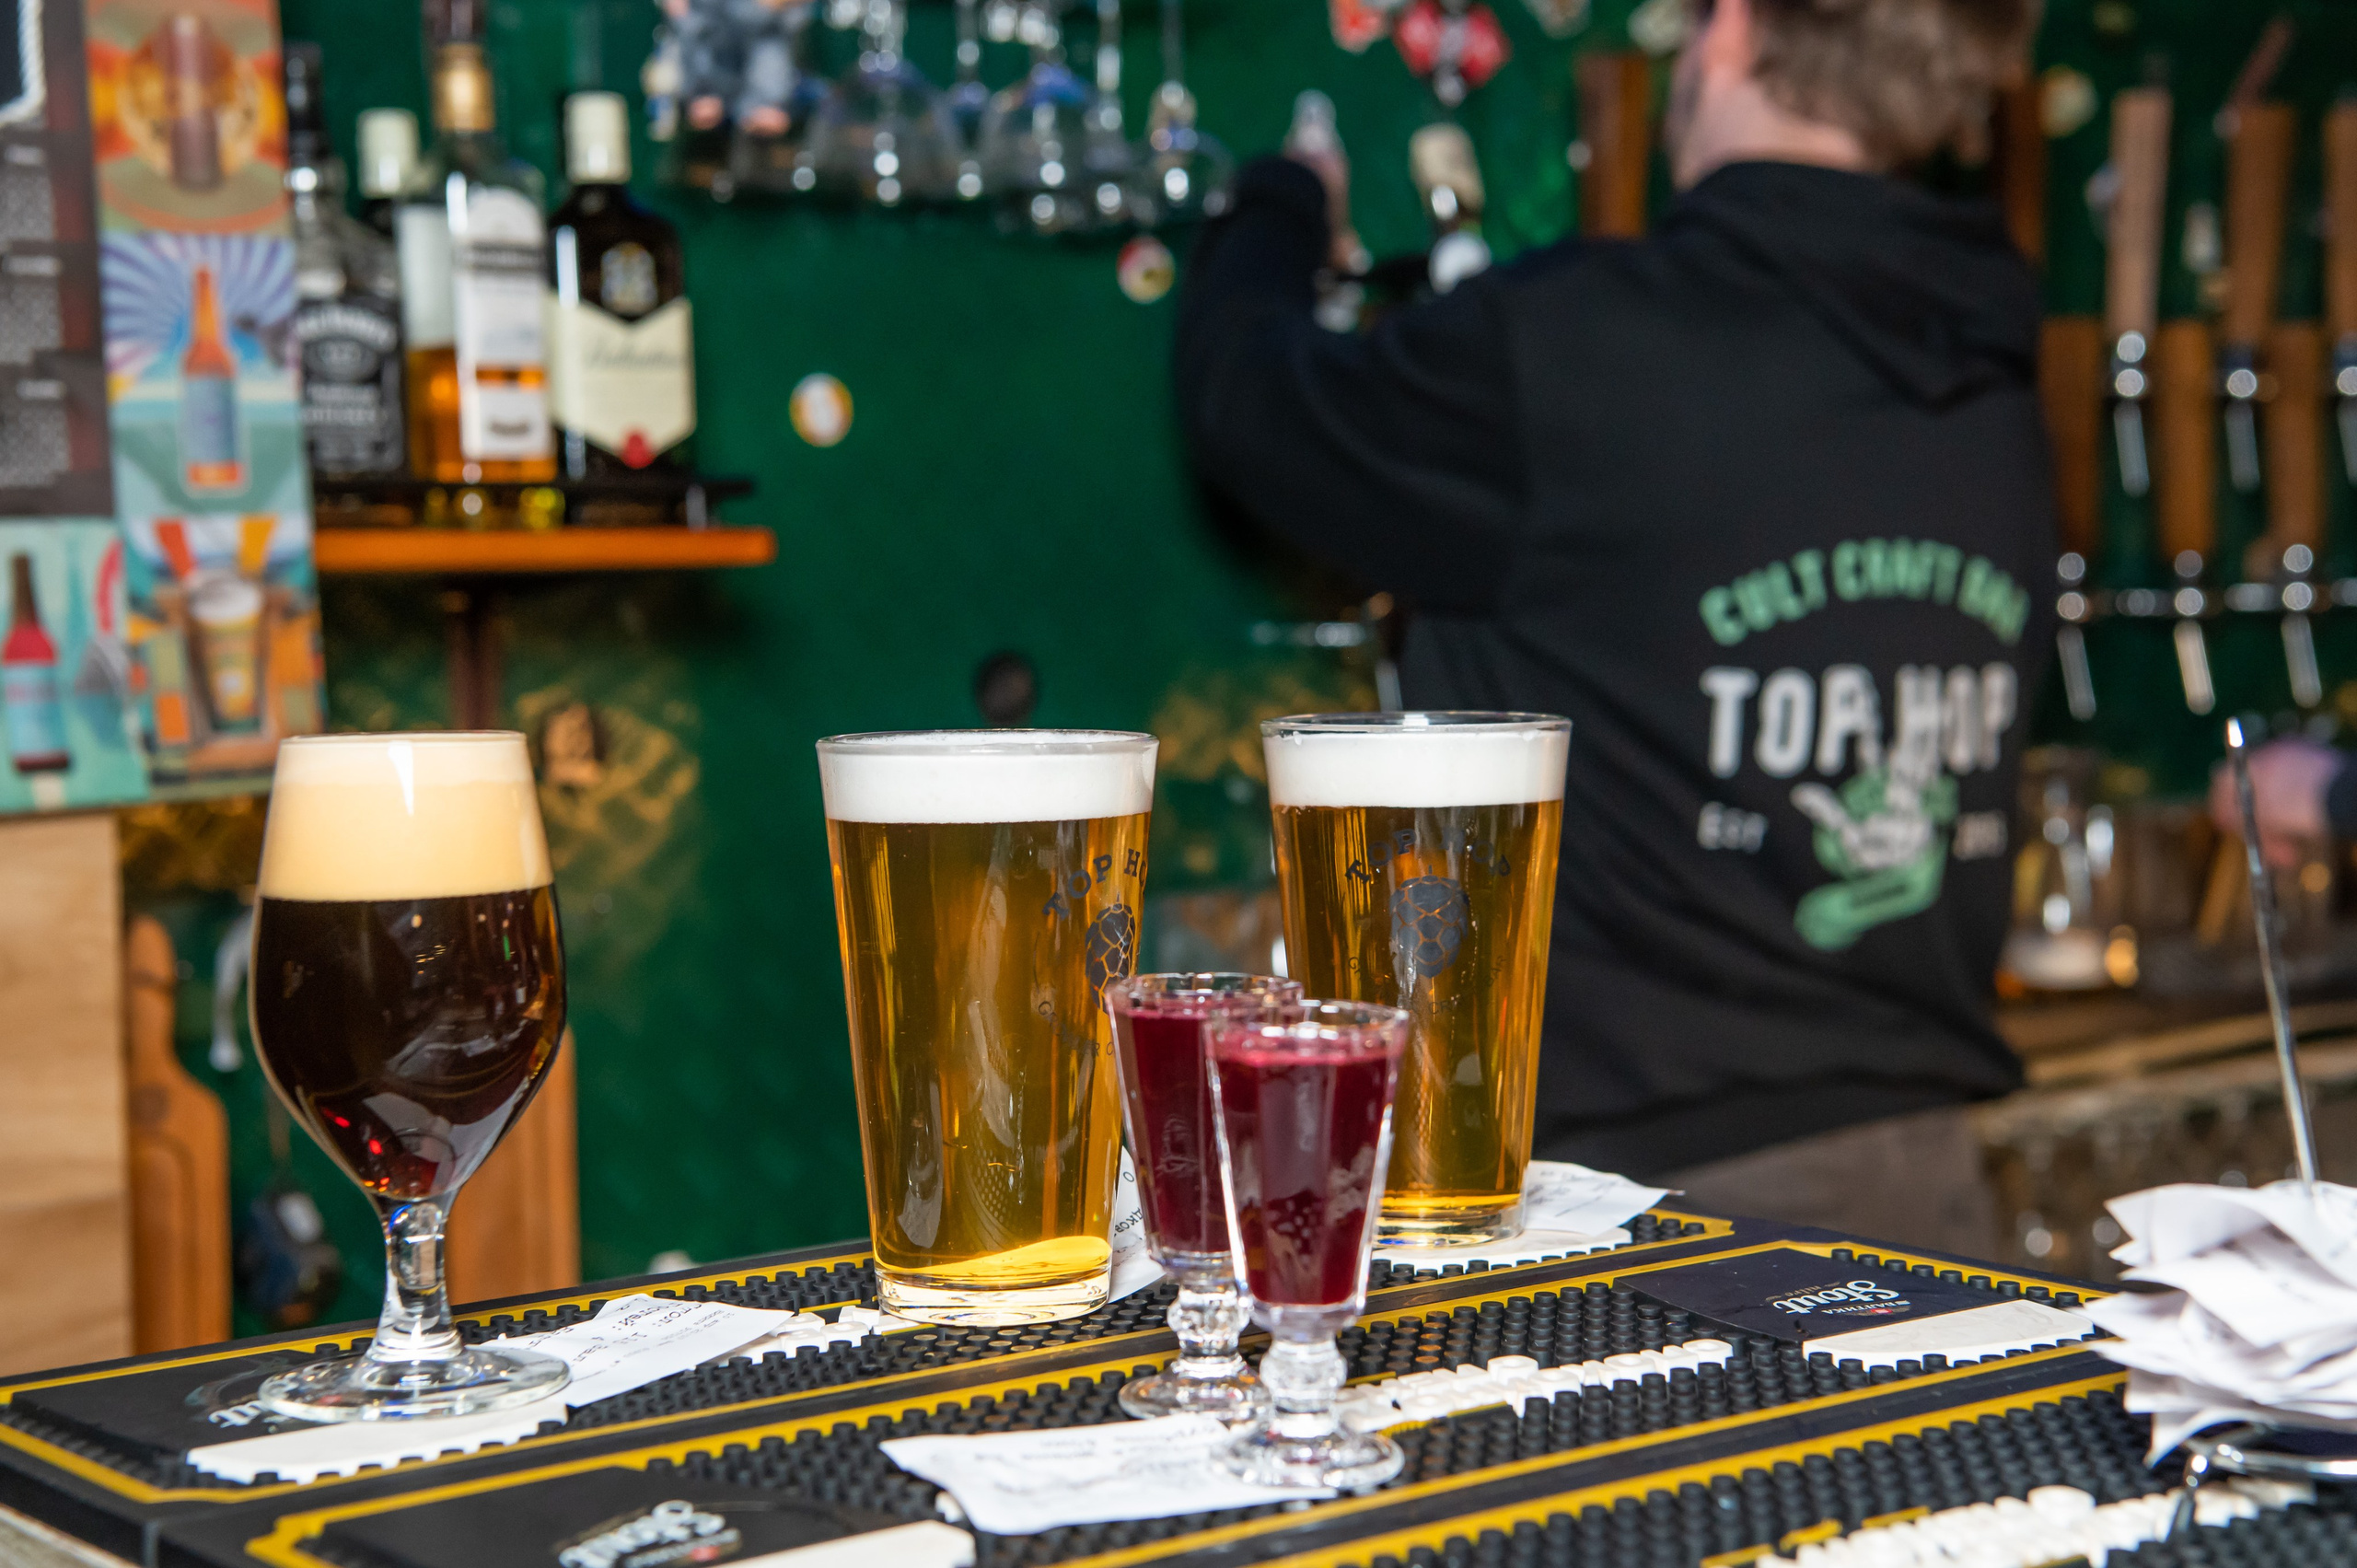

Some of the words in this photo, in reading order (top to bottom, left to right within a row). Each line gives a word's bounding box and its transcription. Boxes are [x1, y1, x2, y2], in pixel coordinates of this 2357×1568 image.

[1042, 854, 1112, 920] TOP
[1124, 848, 1148, 888] HO
[1345, 829, 1417, 884] TOP
[1772, 1280, 1900, 1314] Stout
